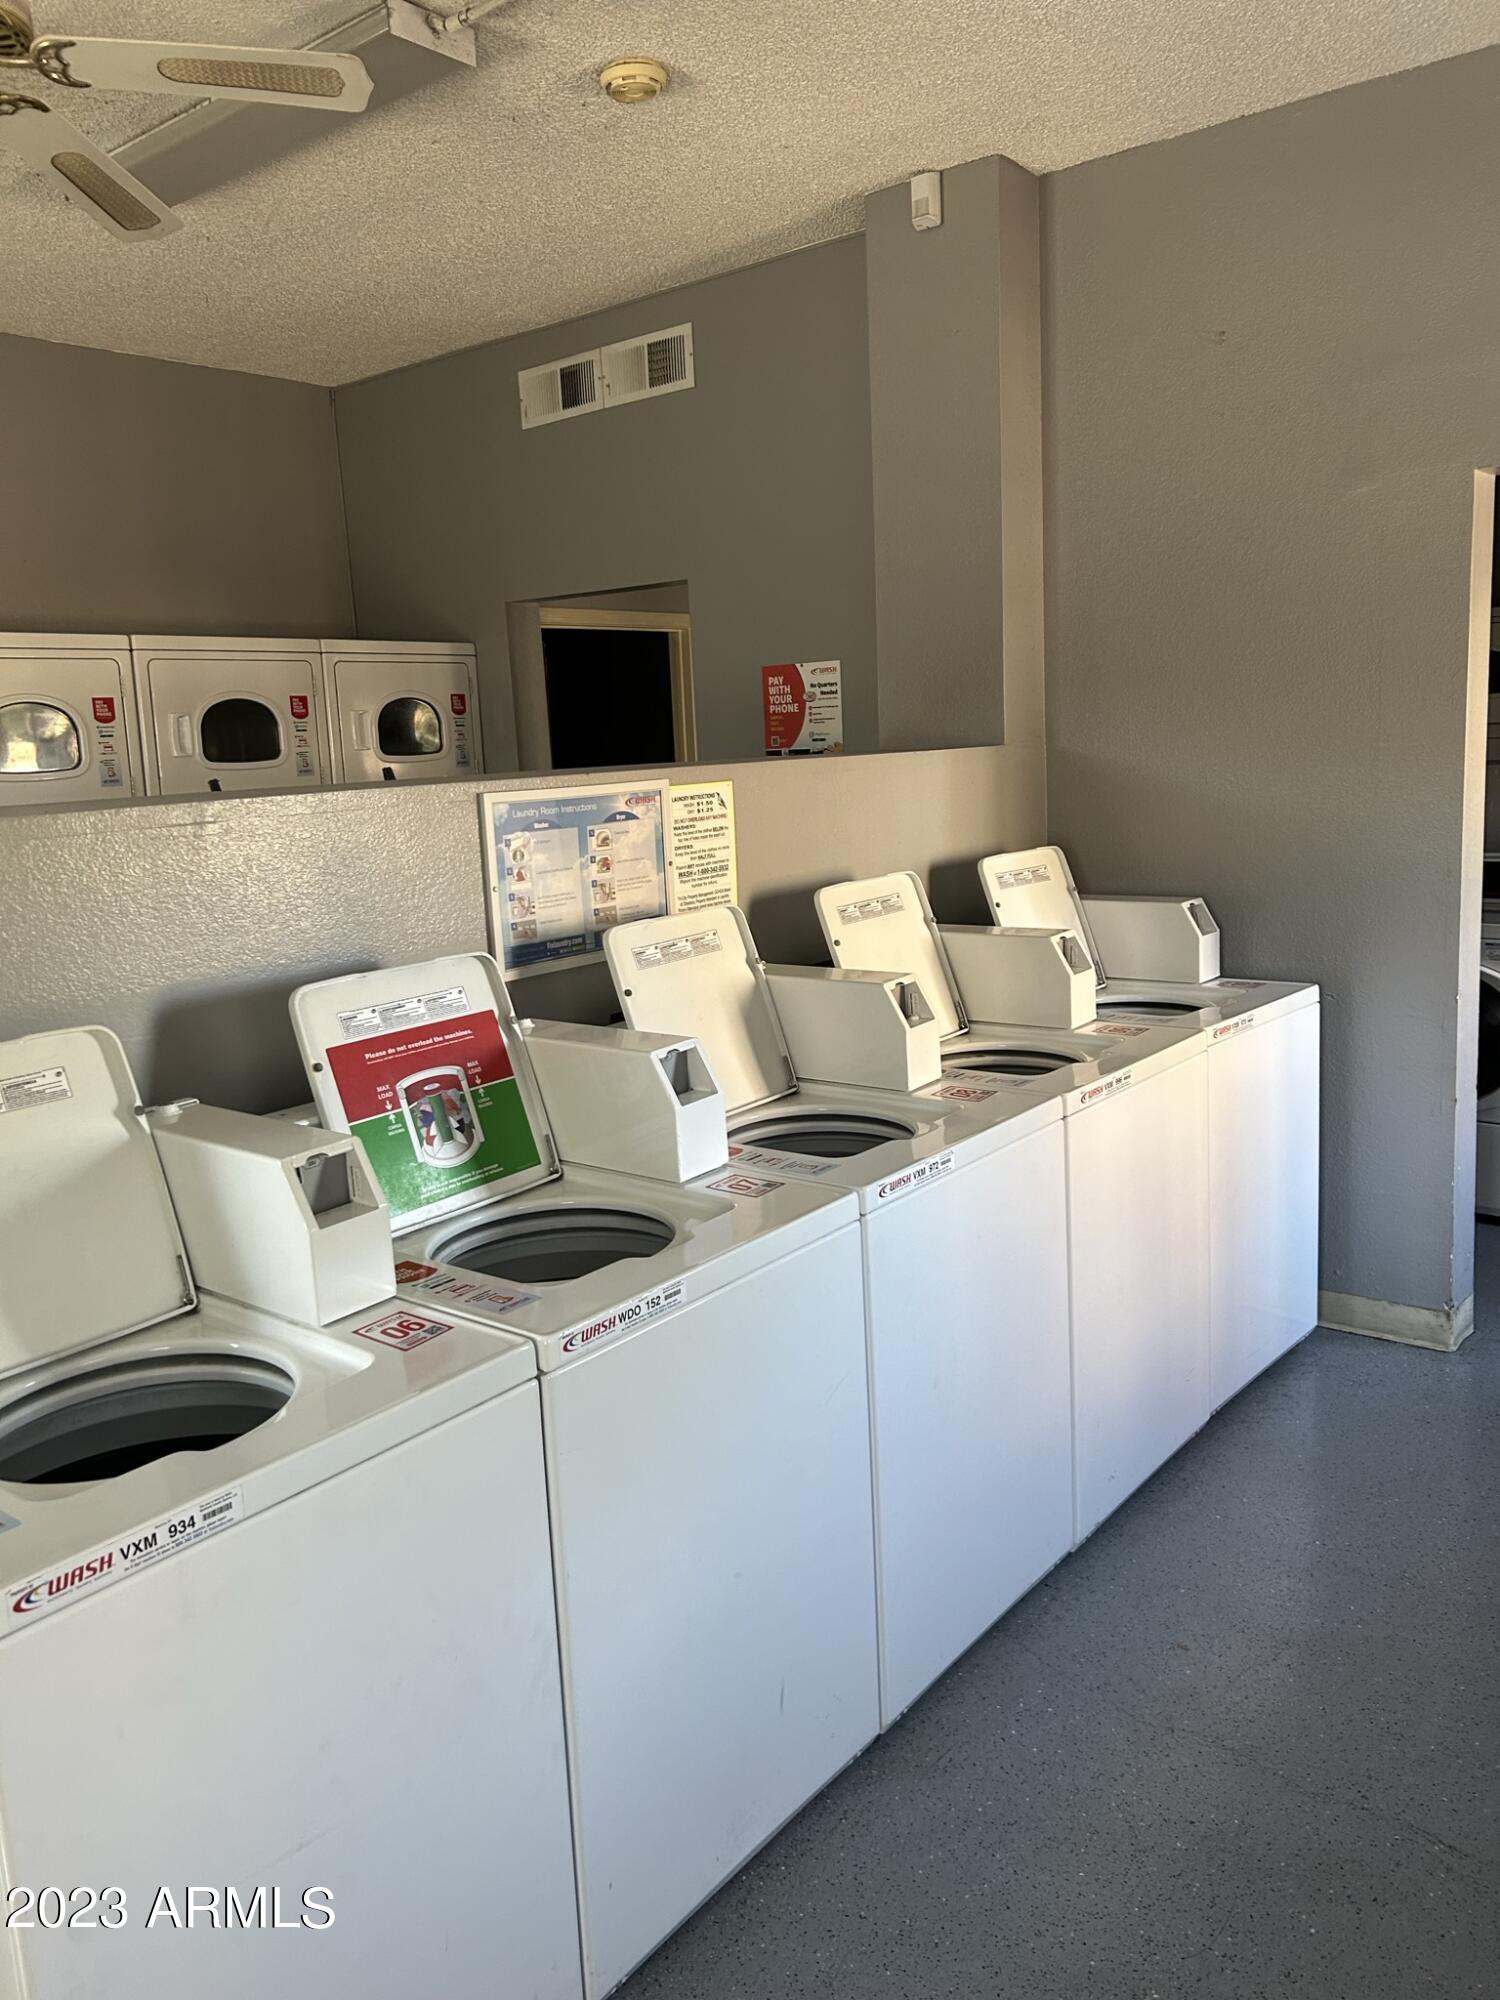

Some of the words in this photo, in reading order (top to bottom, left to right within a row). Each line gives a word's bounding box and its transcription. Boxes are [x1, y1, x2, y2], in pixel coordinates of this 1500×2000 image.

[768, 676, 784, 685] PAY
[768, 685, 791, 695] WITH
[769, 694, 792, 704] YOUR
[769, 704, 799, 713] PHONE
[512, 808, 539, 818] Laundry
[541, 806, 560, 815] Room
[561, 803, 597, 812] Instructions
[364, 1050, 386, 1060] Please
[408, 1038, 433, 1049] overload
[444, 1029, 473, 1040] machines.
[378, 1092, 394, 1100] LOAD
[889, 1173, 912, 1191] WASH
[913, 1168, 926, 1180] VXM
[929, 1161, 939, 1172] 972
[727, 1178, 759, 1190] 07
[581, 1316, 616, 1342] WASH
[618, 1305, 641, 1323] WDO
[645, 1296, 661, 1310] 152
[380, 1319, 426, 1339] 06
[47, 1552, 113, 1596] WASH
[120, 1532, 158, 1560] VXM
[168, 1515, 196, 1538] 934
